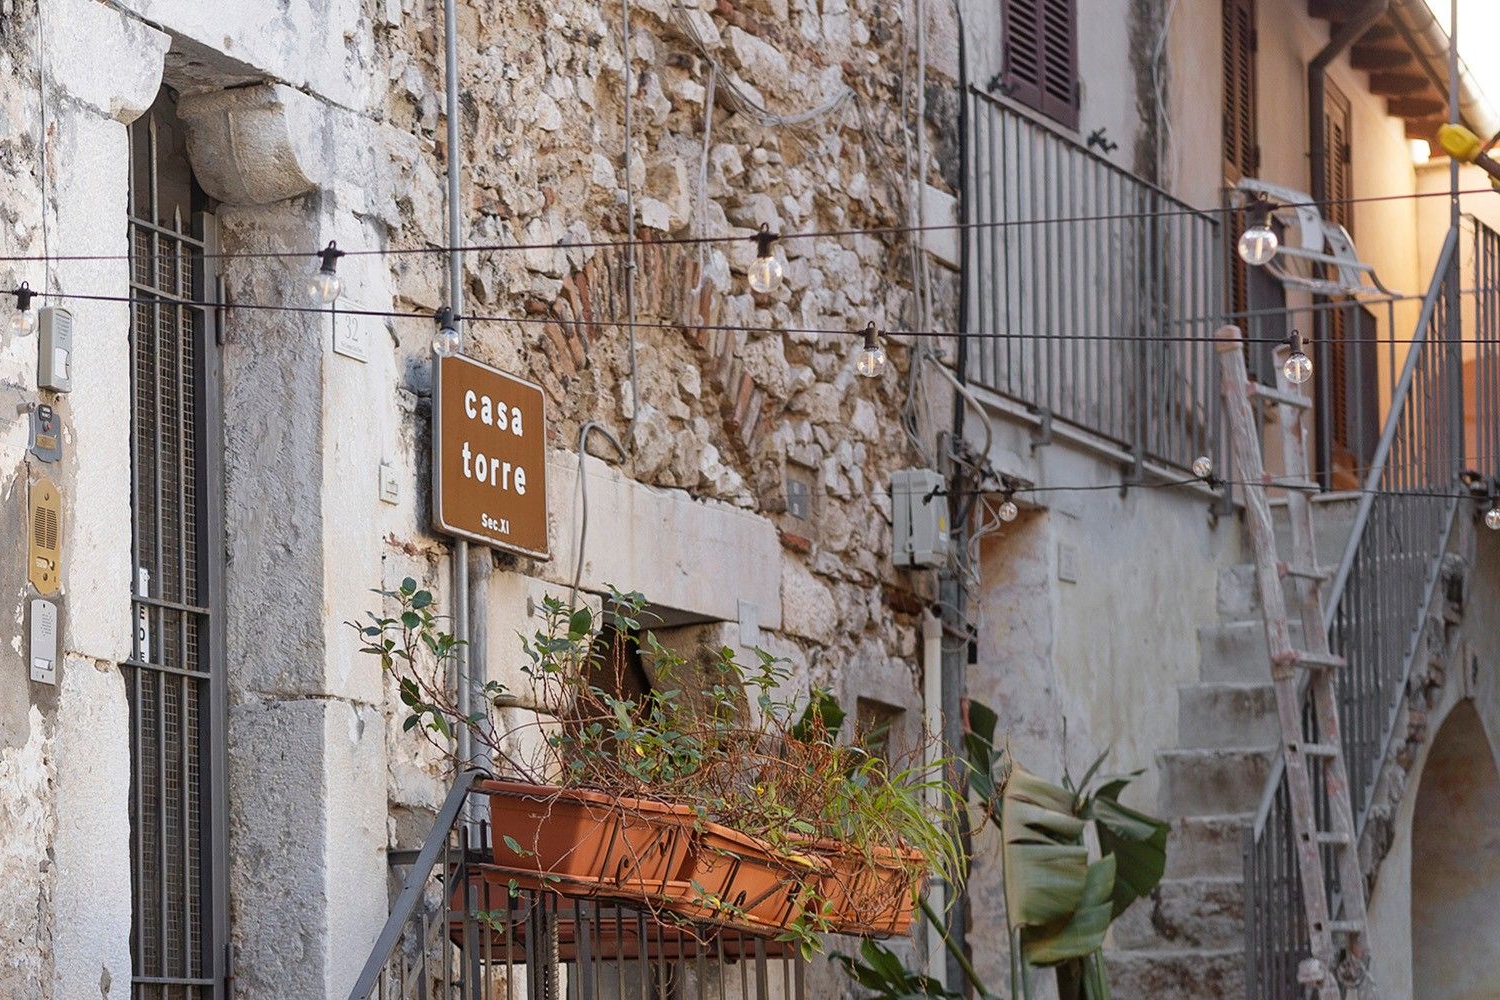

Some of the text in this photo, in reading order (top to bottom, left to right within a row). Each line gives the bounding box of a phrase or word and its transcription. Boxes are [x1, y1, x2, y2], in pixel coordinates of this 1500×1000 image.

[345, 315, 359, 342] 32
[464, 389, 524, 437] casa
[462, 441, 527, 495] torre
[481, 512, 510, 535] Sec.XI
